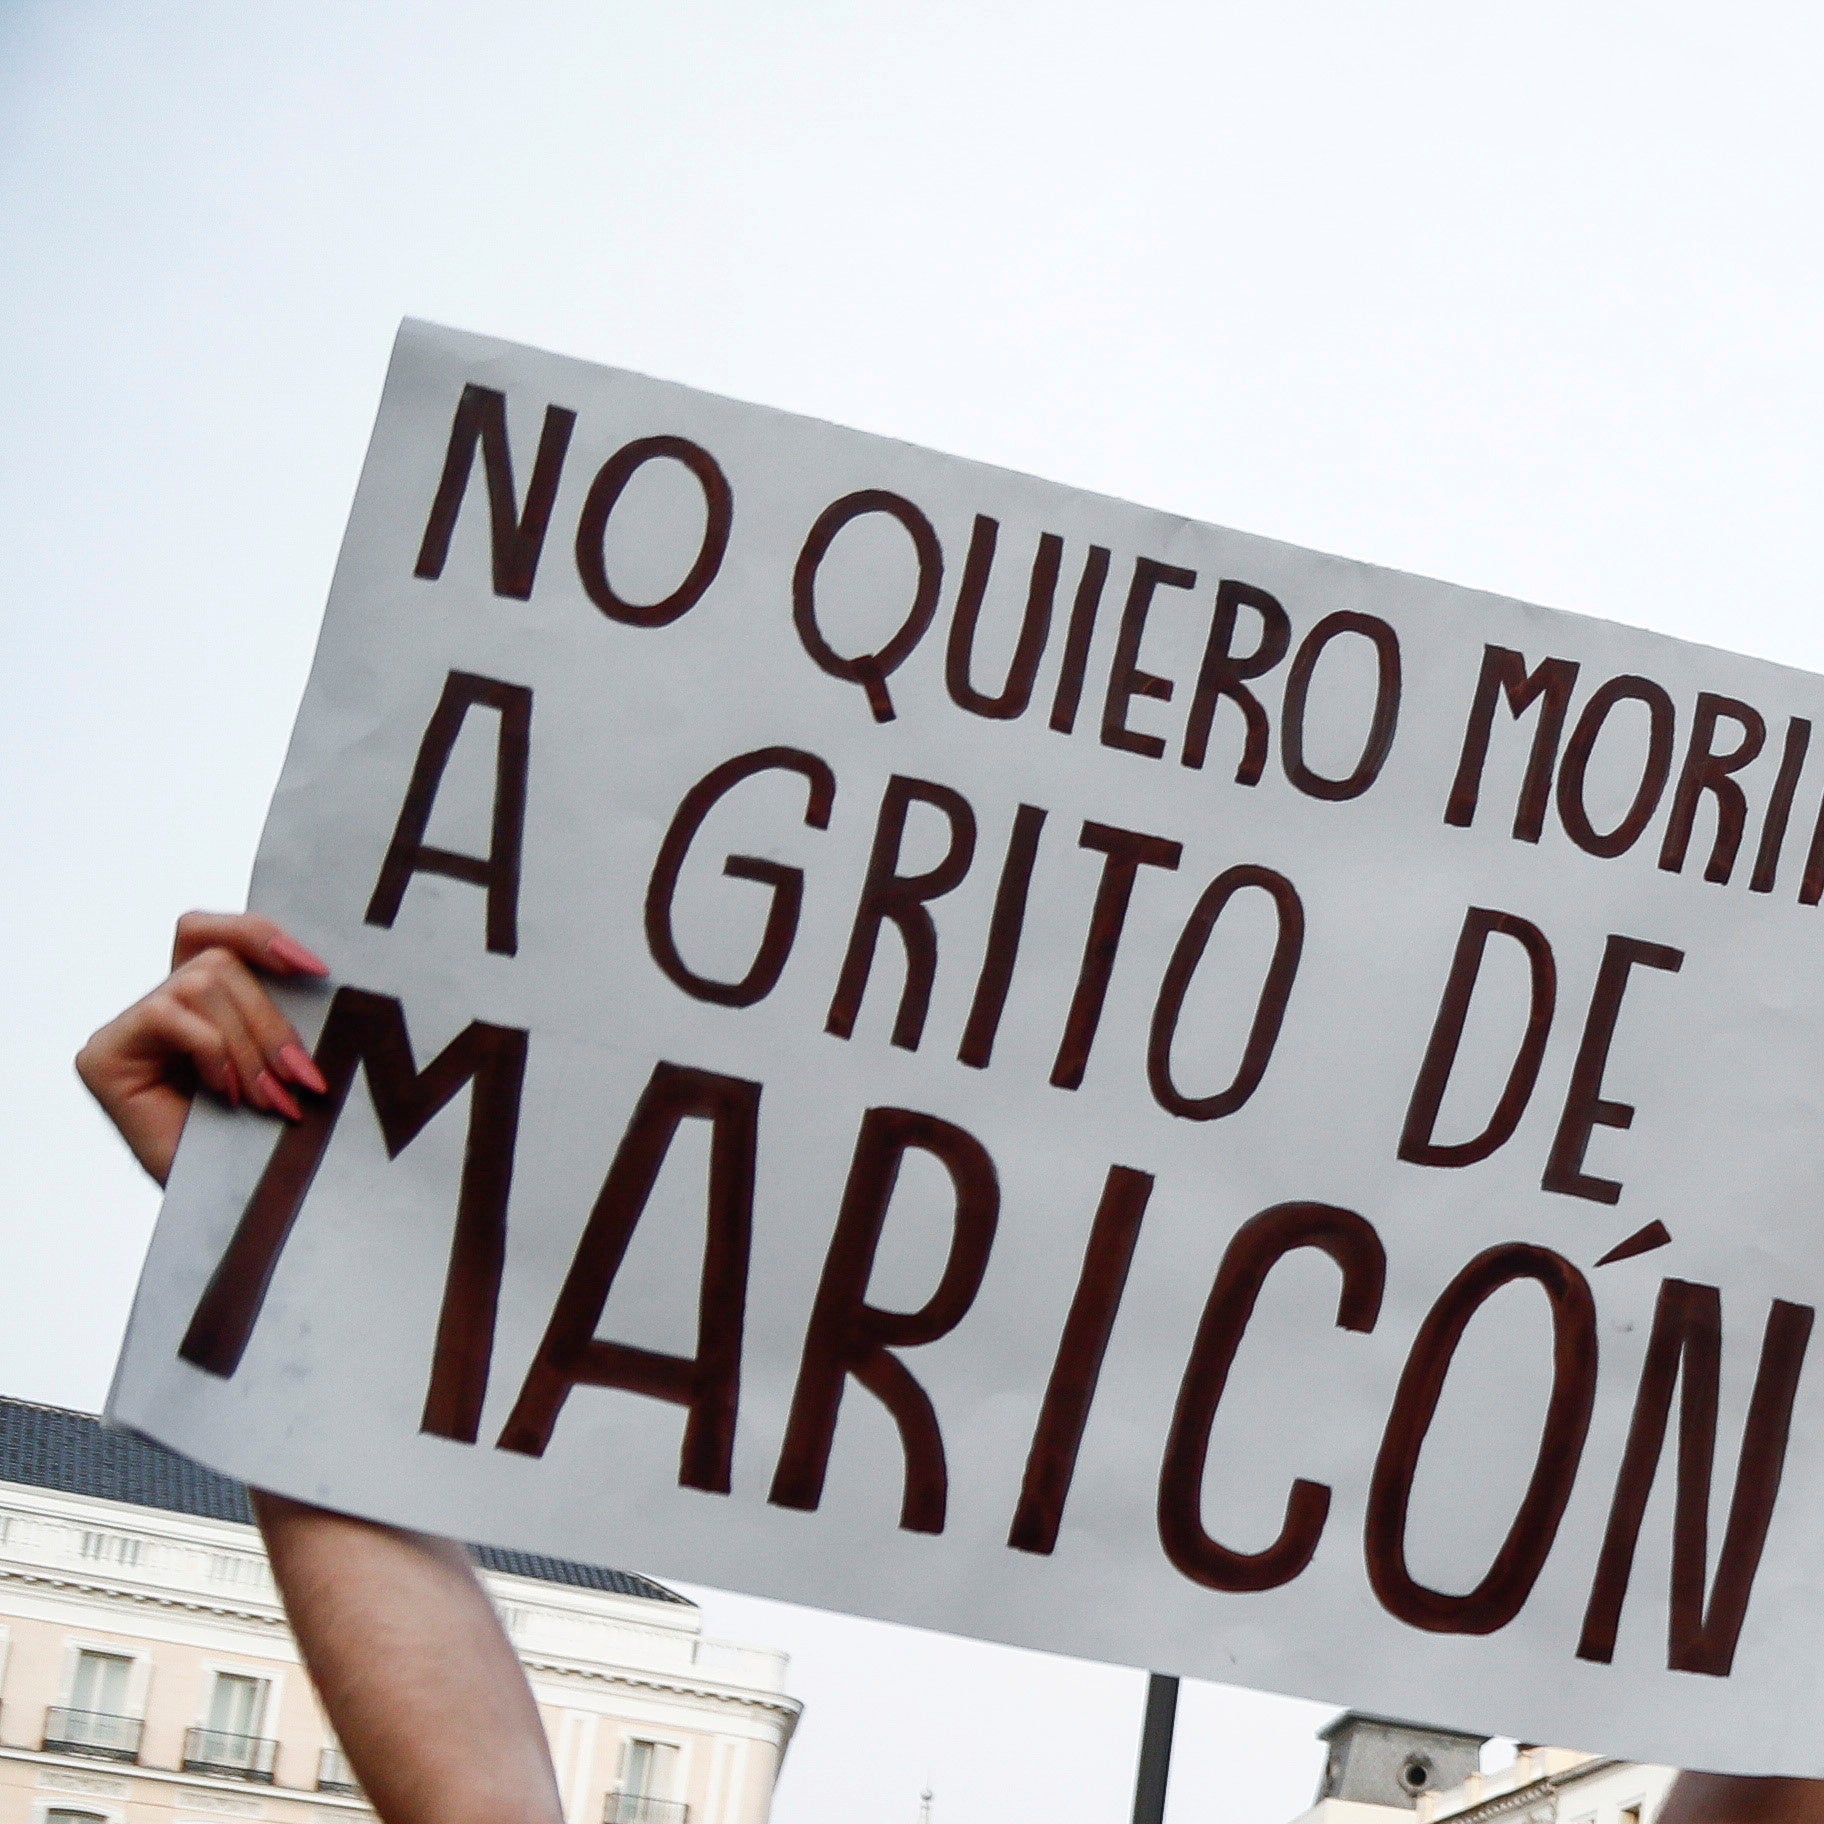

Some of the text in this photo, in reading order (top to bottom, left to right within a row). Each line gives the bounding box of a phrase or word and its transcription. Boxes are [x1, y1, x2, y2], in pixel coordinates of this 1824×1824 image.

[415, 384, 733, 628] NO
[792, 489, 1402, 801] QUIERO
[367, 670, 1686, 1203] A GRITO DE
[178, 986, 1816, 1676] MARICÓN
